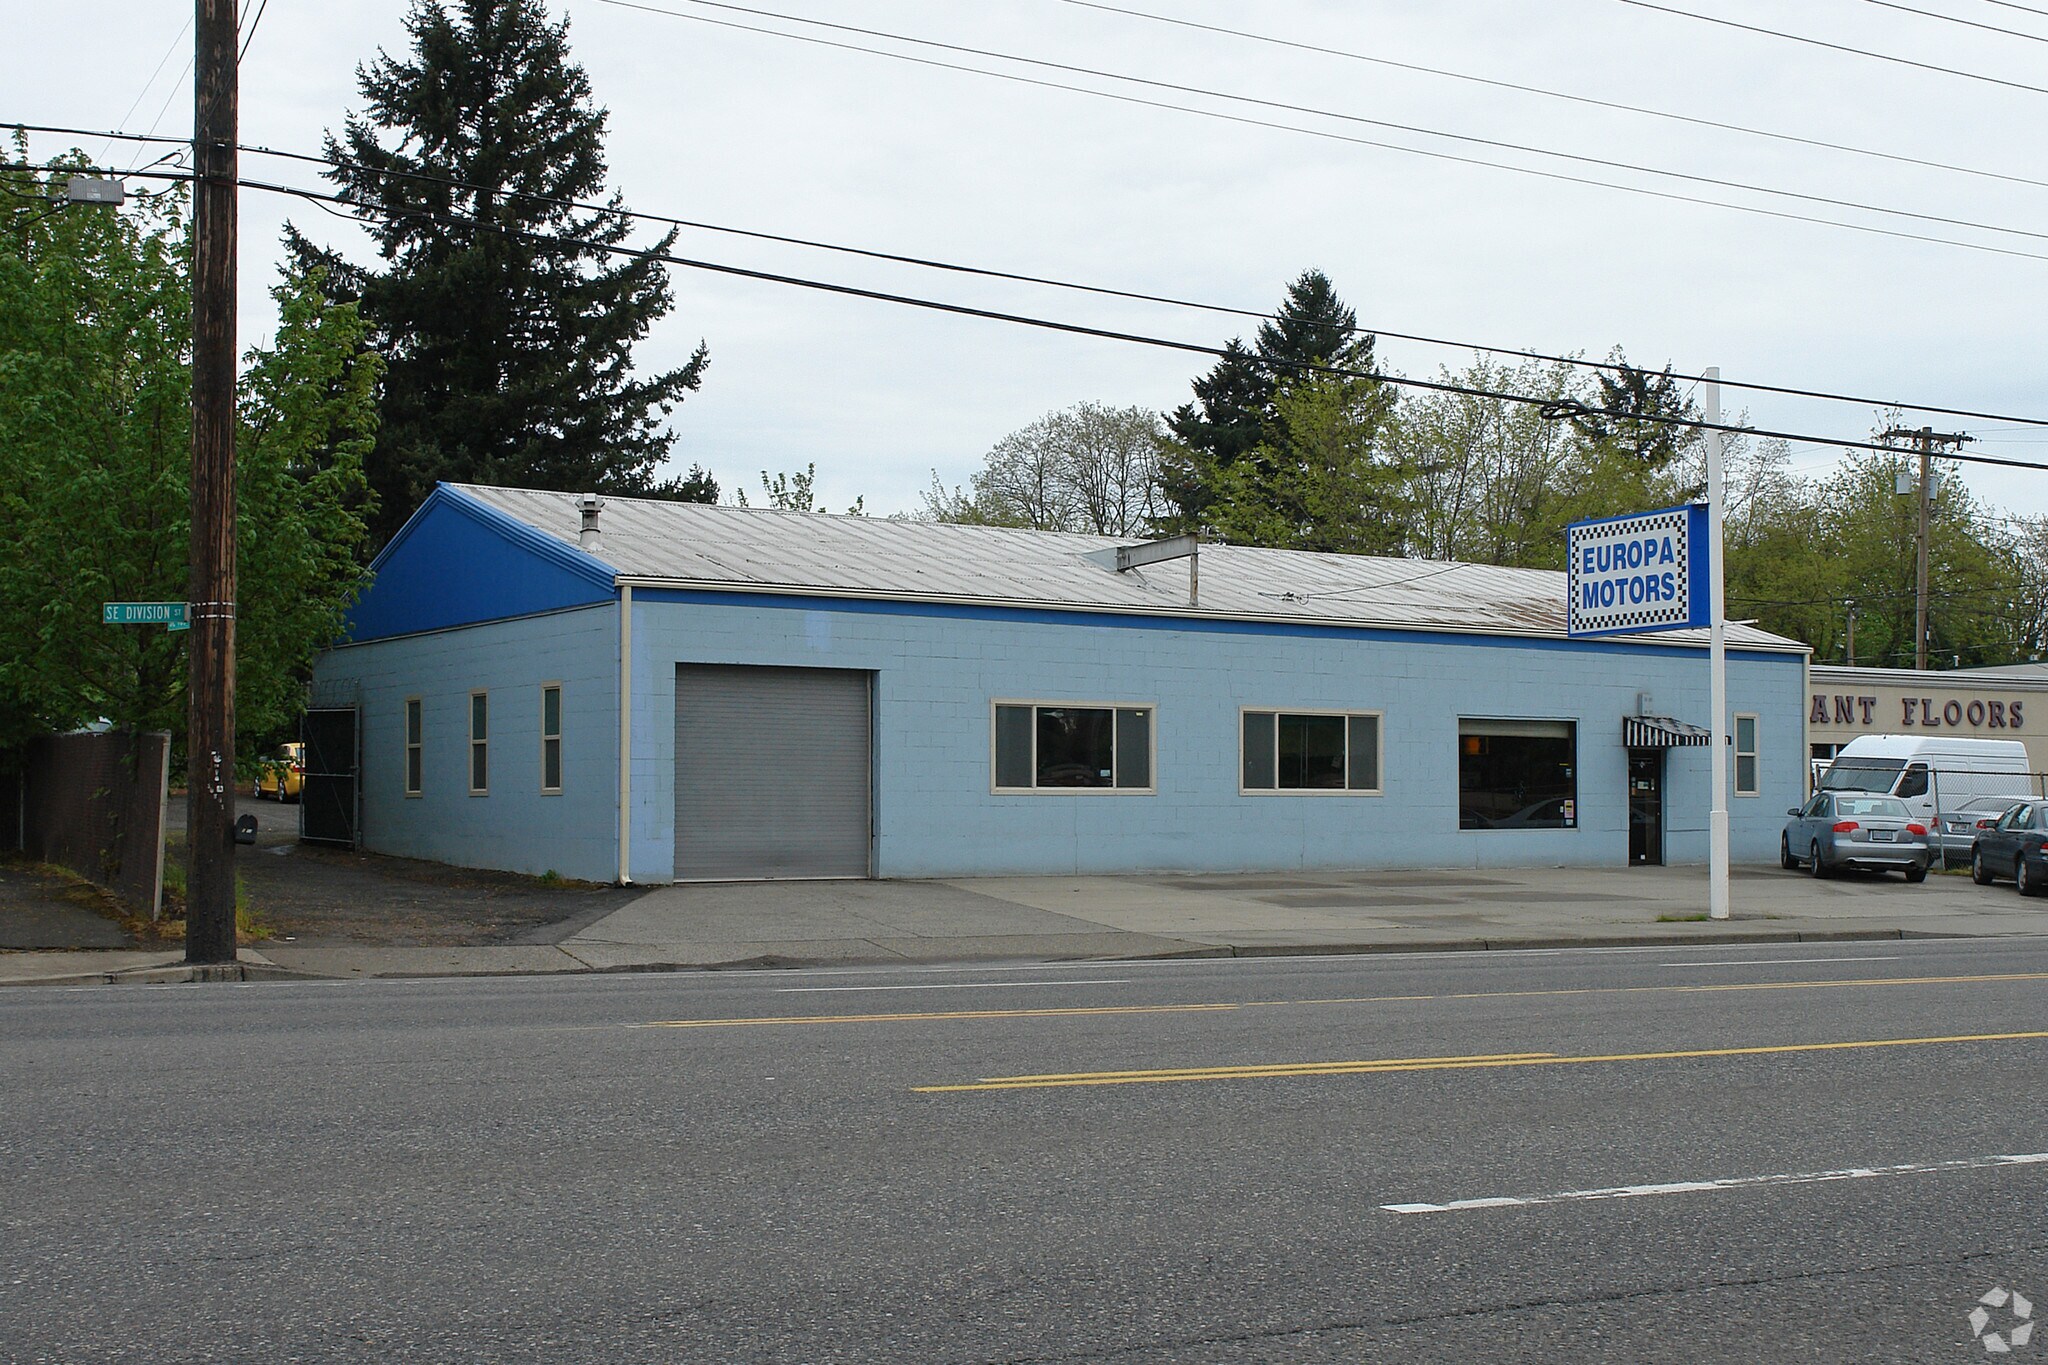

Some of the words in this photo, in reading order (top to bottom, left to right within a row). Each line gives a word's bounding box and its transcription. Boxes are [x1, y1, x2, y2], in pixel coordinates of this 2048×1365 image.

[1583, 536, 1674, 574] EUROPA
[1583, 572, 1675, 609] MOTORS
[106, 606, 119, 619] SE
[126, 606, 170, 619] DIVISION
[174, 608, 181, 616] ST
[1902, 698, 2024, 728] FLOORS
